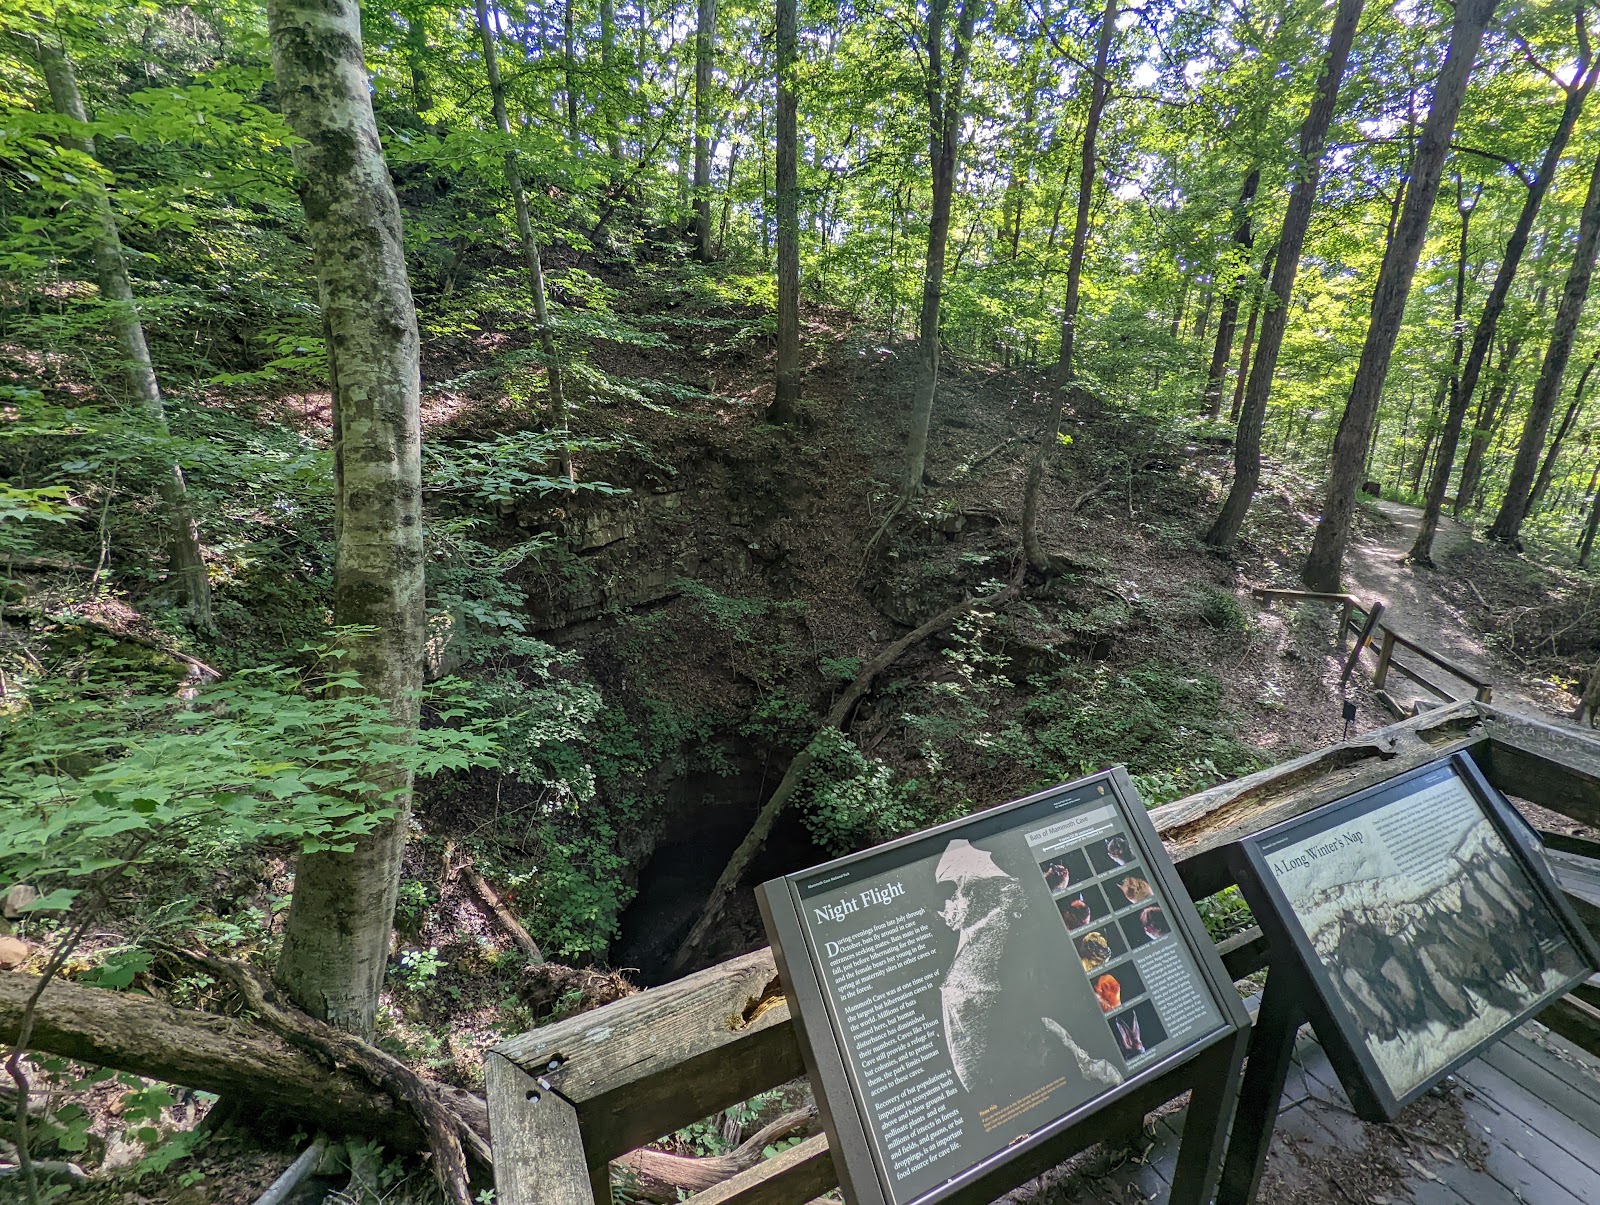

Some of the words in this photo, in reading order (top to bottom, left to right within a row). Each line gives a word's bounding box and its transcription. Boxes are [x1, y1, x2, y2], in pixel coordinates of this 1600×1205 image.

[1029, 832, 1042, 842] Bats
[1041, 829, 1049, 837] of
[1048, 820, 1076, 835] Mammoth
[1075, 816, 1089, 825] Cave
[1273, 863, 1284, 877] A
[1281, 853, 1310, 874] Long
[1305, 837, 1345, 861] Winter's
[1342, 830, 1364, 847] Nap
[813, 896, 861, 926] Night
[859, 880, 906, 910] Flight
[824, 935, 853, 958] During
[851, 927, 874, 942] evenings
[873, 922, 887, 932] from
[886, 919, 896, 927] late
[895, 915, 906, 925] July
[905, 908, 926, 920] through
[829, 952, 856, 967] entrances
[854, 945, 876, 959] seeking
[874, 939, 891, 950] mates.
[890, 934, 903, 943] Bats
[919, 924, 929, 932] the
[839, 940, 863, 954] October,
[861, 936, 874, 945] bats
[880, 925, 900, 938] around
[904, 921, 916, 929] cave
[832, 965, 844, 976] fall,
[842, 962, 854, 973] just
[852, 956, 870, 968] before
[869, 944, 900, 961] hibernating
[898, 941, 908, 950] for
[906, 938, 916, 946] the
[835, 974, 846, 984] and
[845, 971, 855, 980] the
[854, 964, 873, 976] female
[872, 958, 887, 969] bears
[886, 955, 897, 964] her
[895, 950, 913, 962] young
[911, 946, 918, 954] in
[917, 943, 926, 951] the
[837, 981, 856, 994] spring
[854, 978, 861, 986] at
[860, 968, 886, 984] maternity
[885, 964, 898, 974] sites
[896, 960, 904, 969] in
[902, 956, 917, 966] other
[916, 951, 931, 961] caves
[839, 994, 847, 1002] in
[846, 990, 856, 999] the
[855, 983, 874, 995] forest.
[844, 997, 873, 1014] Mammoth
[872, 992, 886, 1003] Cave
[885, 988, 897, 997] was
[896, 985, 903, 993] at
[902, 982, 913, 990] one
[911, 976, 924, 986] time
[923, 973, 934, 981] one
[933, 969, 940, 977] of
[847, 1014, 857, 1023] the
[856, 1006, 875, 1020] largest
[873, 1002, 884, 1012] bat
[883, 990, 914, 1008] hibernation
[913, 985, 928, 995] caves
[850, 1023, 860, 1032] the
[859, 1015, 878, 1028] world.
[876, 1006, 900, 1021] Millions
[899, 1002, 906, 1011] of
[904, 999, 917, 1008] bats
[853, 1026, 874, 1041] roosted
[873, 1021, 888, 1032] here,
[886, 1016, 898, 1026] but
[896, 1009, 917, 1022] human
[856, 1031, 888, 1050] disturbance
[886, 1027, 898, 1037] has
[896, 1013, 926, 1032] diminished
[858, 1048, 873, 1060] their
[896, 1030, 913, 1042] Caves
[912, 1026, 923, 1035] like
[922, 1018, 940, 1031] Dixon
[861, 1057, 876, 1069] Cave
[875, 1051, 887, 1063] still
[886, 1043, 907, 1059] provide
[910, 1034, 928, 1047] refuge
[926, 1030, 936, 1039] for
[864, 1068, 875, 1078] bat
[873, 1058, 899, 1074] colonies,
[897, 1051, 909, 1063] and
[908, 1050, 915, 1058] to
[914, 1040, 934, 1057] protect
[867, 1075, 885, 1088] them,
[883, 1070, 893, 1080] the
[892, 1063, 907, 1078] park
[905, 1057, 921, 1069] limits
[920, 1049, 940, 1062] human
[870, 1084, 889, 1097] access
[887, 1080, 895, 1089] to
[894, 1073, 909, 1086] these
[908, 1067, 925, 1078] caves.
[874, 1093, 901, 1112] Recovery
[900, 1089, 907, 1099] of
[906, 1085, 917, 1095] bat
[915, 1071, 948, 1093] populations
[946, 1068, 952, 1076] is
[877, 1102, 907, 1122] important
[905, 1099, 913, 1107] to
[911, 1084, 942, 1105] ecosystems
[940, 1077, 954, 1090] both
[881, 1117, 898, 1131] above
[897, 1110, 909, 1122] and
[908, 1103, 925, 1117] below
[924, 1092, 947, 1110] ground.
[945, 1087, 958, 1098] Bats
[884, 1122, 909, 1143] pollinate
[908, 1114, 926, 1130] plants
[926, 1107, 938, 1119] and
[937, 1103, 947, 1113] eat
[887, 1133, 911, 1151] millions
[909, 1128, 917, 1139] of
[916, 1120, 936, 1135] insects
[934, 1115, 942, 1126] in
[941, 1108, 960, 1122] forests
[890, 1148, 903, 1161] and
[901, 1140, 920, 1155] fields,
[918, 1133, 930, 1146] and
[929, 1126, 949, 1142] guano,
[947, 1122, 955, 1130] or
[953, 1116, 964, 1127] bat
[893, 1150, 924, 1171] droppings,
[922, 1146, 929, 1155] is
[928, 1143, 937, 1152] an
[935, 1128, 964, 1148] important
[896, 1166, 911, 1181] food
[910, 1159, 930, 1174] source
[928, 1153, 938, 1163] for
[937, 1147, 951, 1158] cave
[949, 1140, 962, 1152] life.
